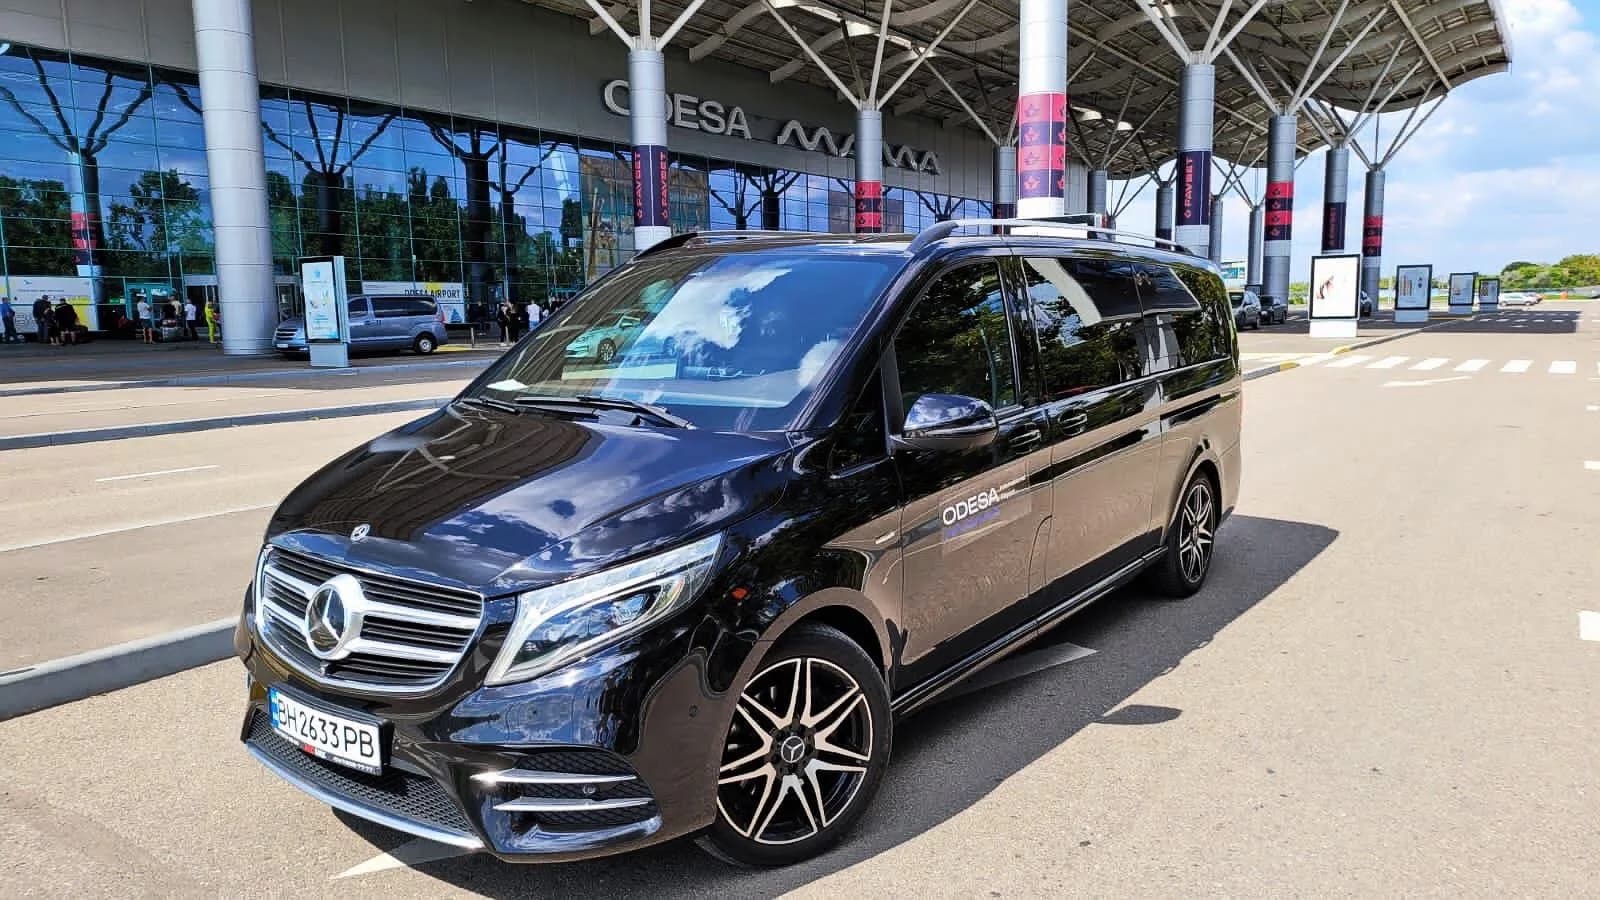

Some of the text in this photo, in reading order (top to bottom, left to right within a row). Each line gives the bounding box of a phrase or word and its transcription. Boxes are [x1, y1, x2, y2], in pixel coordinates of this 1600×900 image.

[634, 152, 642, 208] FAVBET
[1184, 156, 1193, 208] FAVBET
[430, 289, 460, 298] AIRPORT
[942, 487, 1000, 526] ODESA
